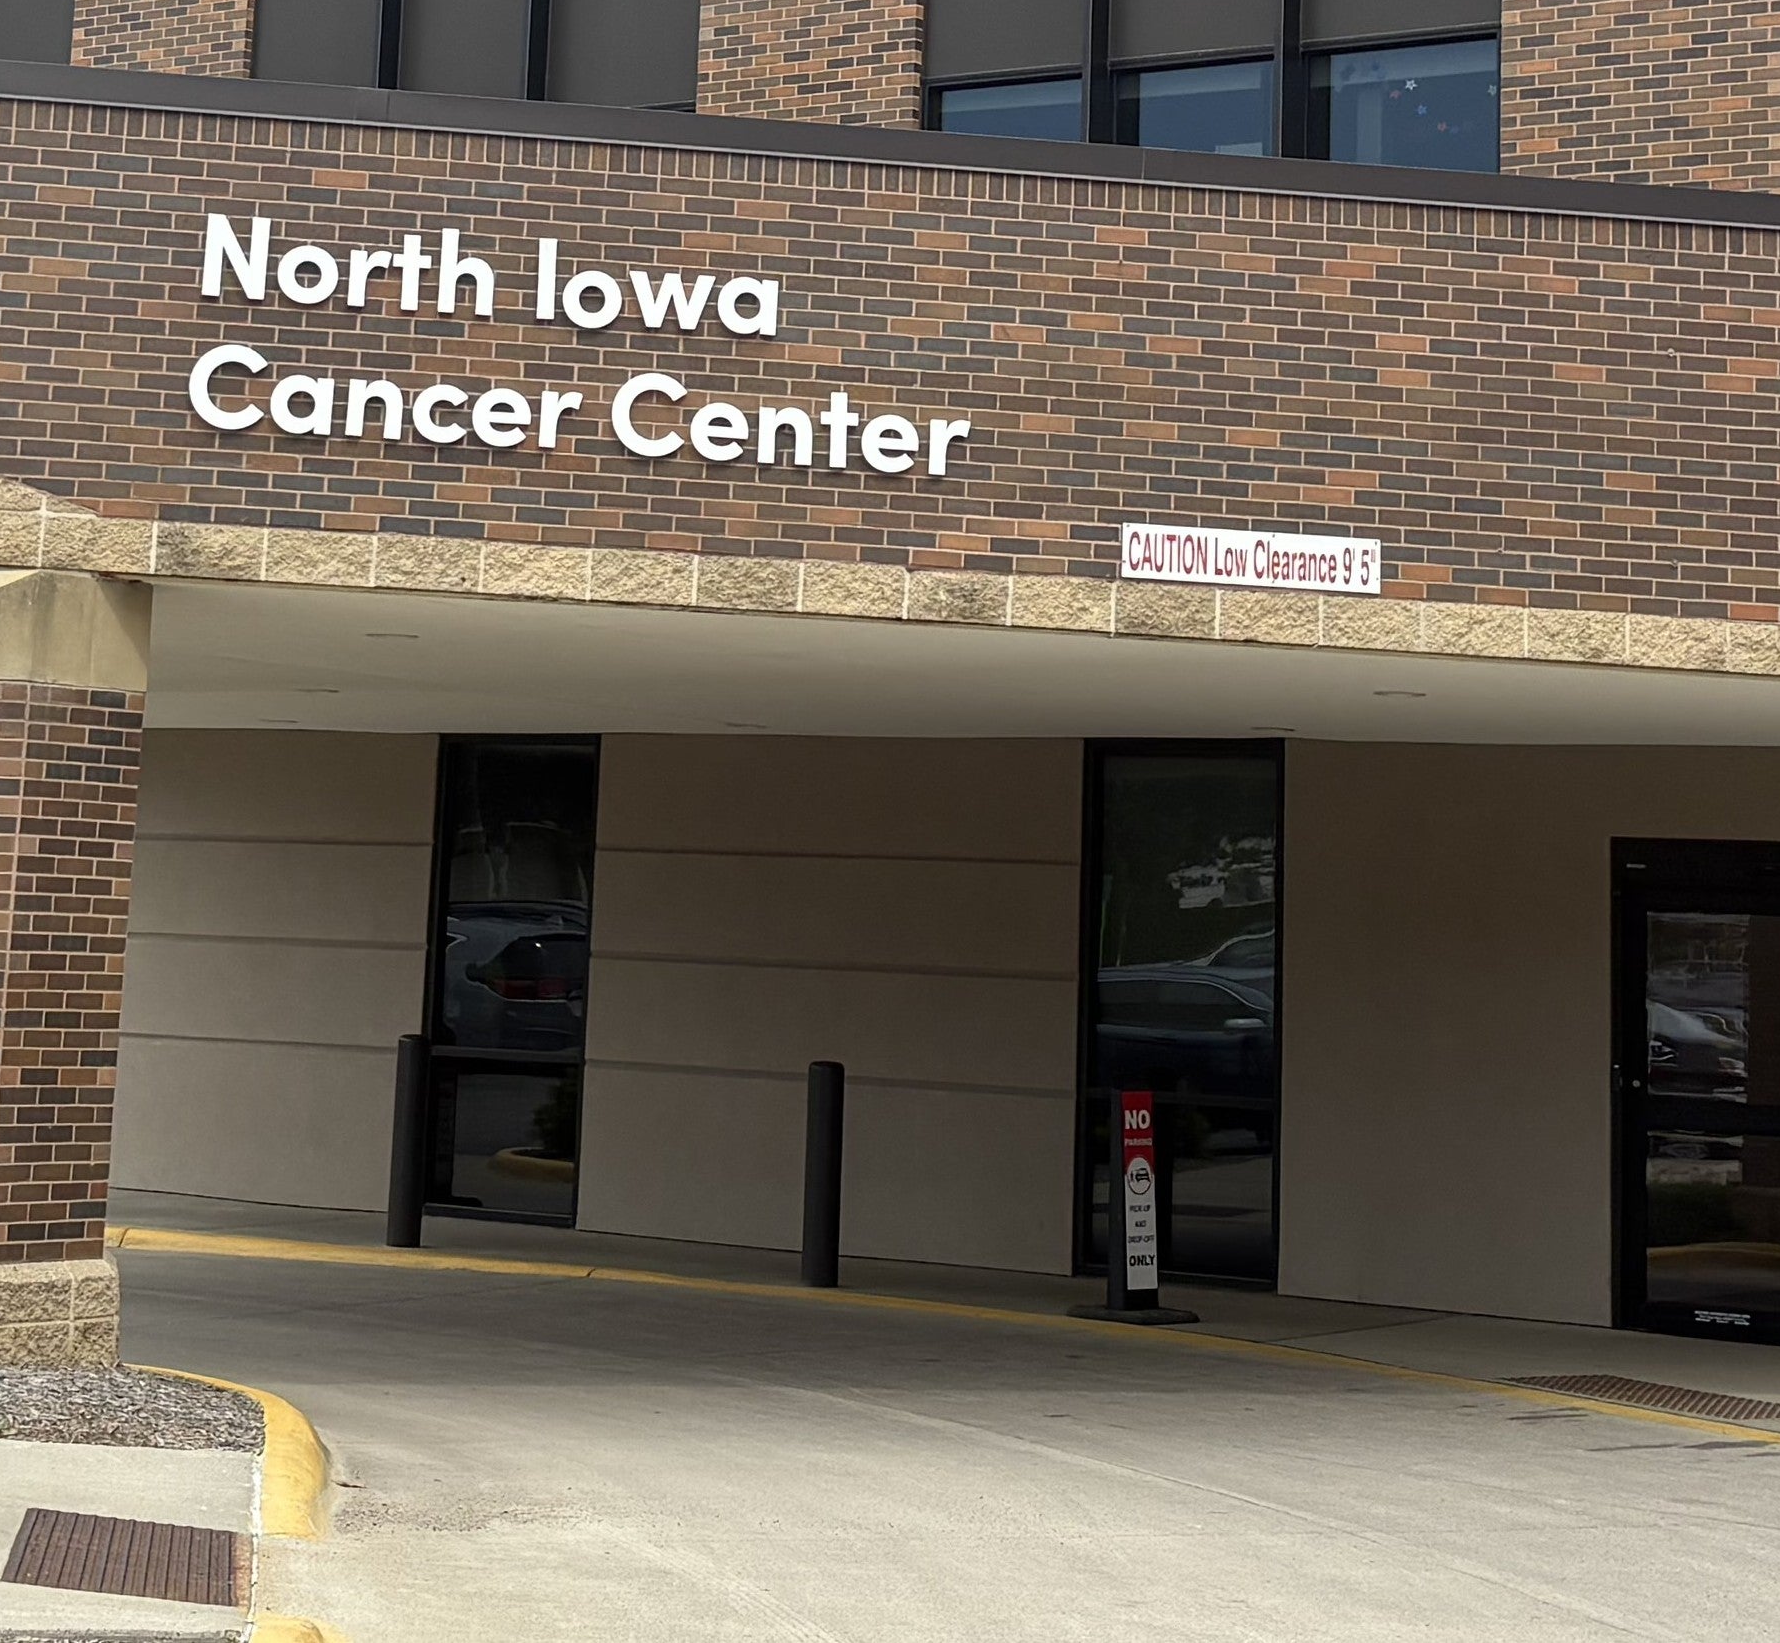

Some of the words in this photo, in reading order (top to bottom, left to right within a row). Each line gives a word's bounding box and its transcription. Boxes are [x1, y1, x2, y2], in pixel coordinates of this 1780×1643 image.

[200, 213, 495, 318] North
[536, 237, 780, 337] Iowa
[188, 344, 583, 449] Cancer
[611, 372, 971, 476] Center
[1128, 531, 1208, 575] CAUTION
[1214, 537, 1248, 577] Low
[1253, 539, 1337, 584] Clearance
[1124, 1109, 1151, 1130] NO
[1128, 1254, 1156, 1267] ONLY
